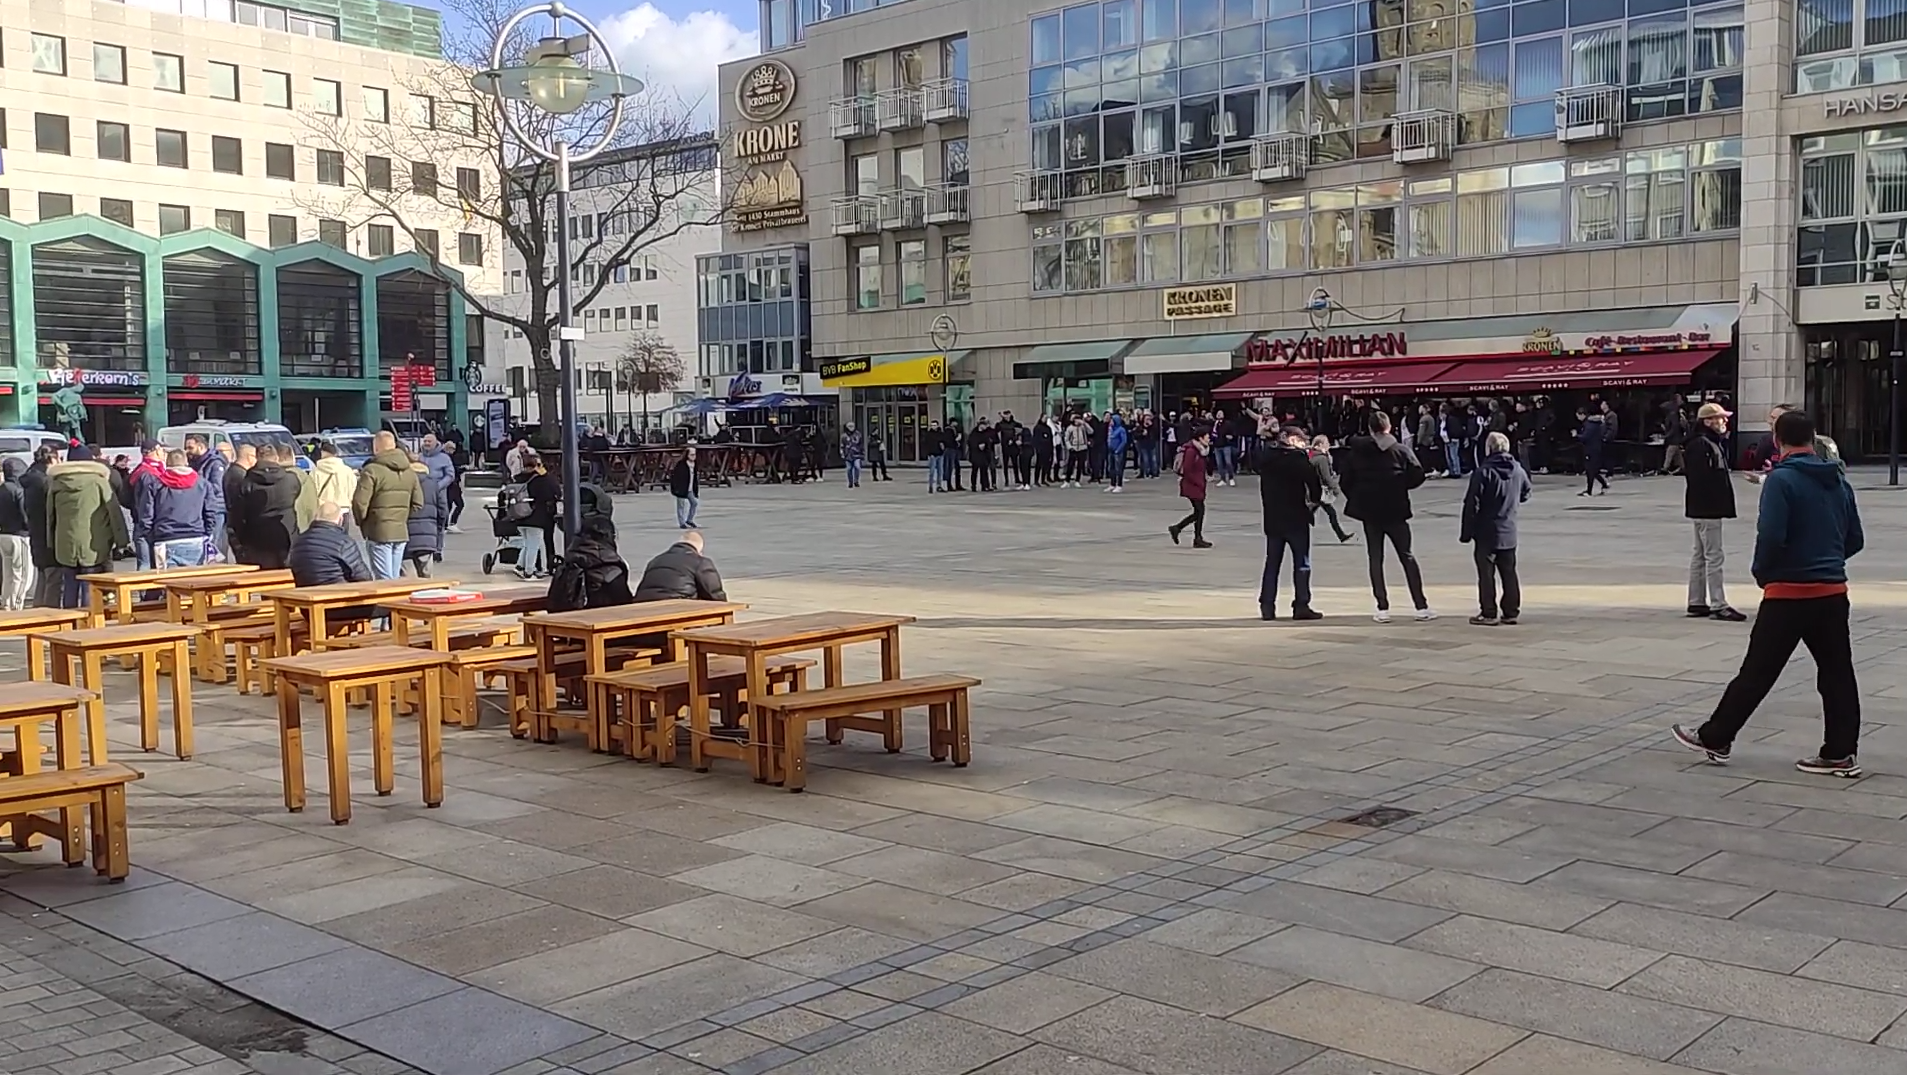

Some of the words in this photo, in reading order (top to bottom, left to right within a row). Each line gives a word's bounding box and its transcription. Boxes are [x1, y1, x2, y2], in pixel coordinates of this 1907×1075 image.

[749, 92, 780, 107] KRONEN
[734, 121, 799, 157] KRONE
[760, 151, 784, 163] MARKT
[763, 208, 800, 219] Stammhaus
[1167, 287, 1233, 305] KRONEN
[1167, 303, 1233, 316] PASSAGE
[1246, 332, 1407, 361] MAXIMILIAN
[1522, 340, 1561, 353] KRONEN
[822, 366, 837, 376] BVB
[837, 360, 867, 374] FanShop
